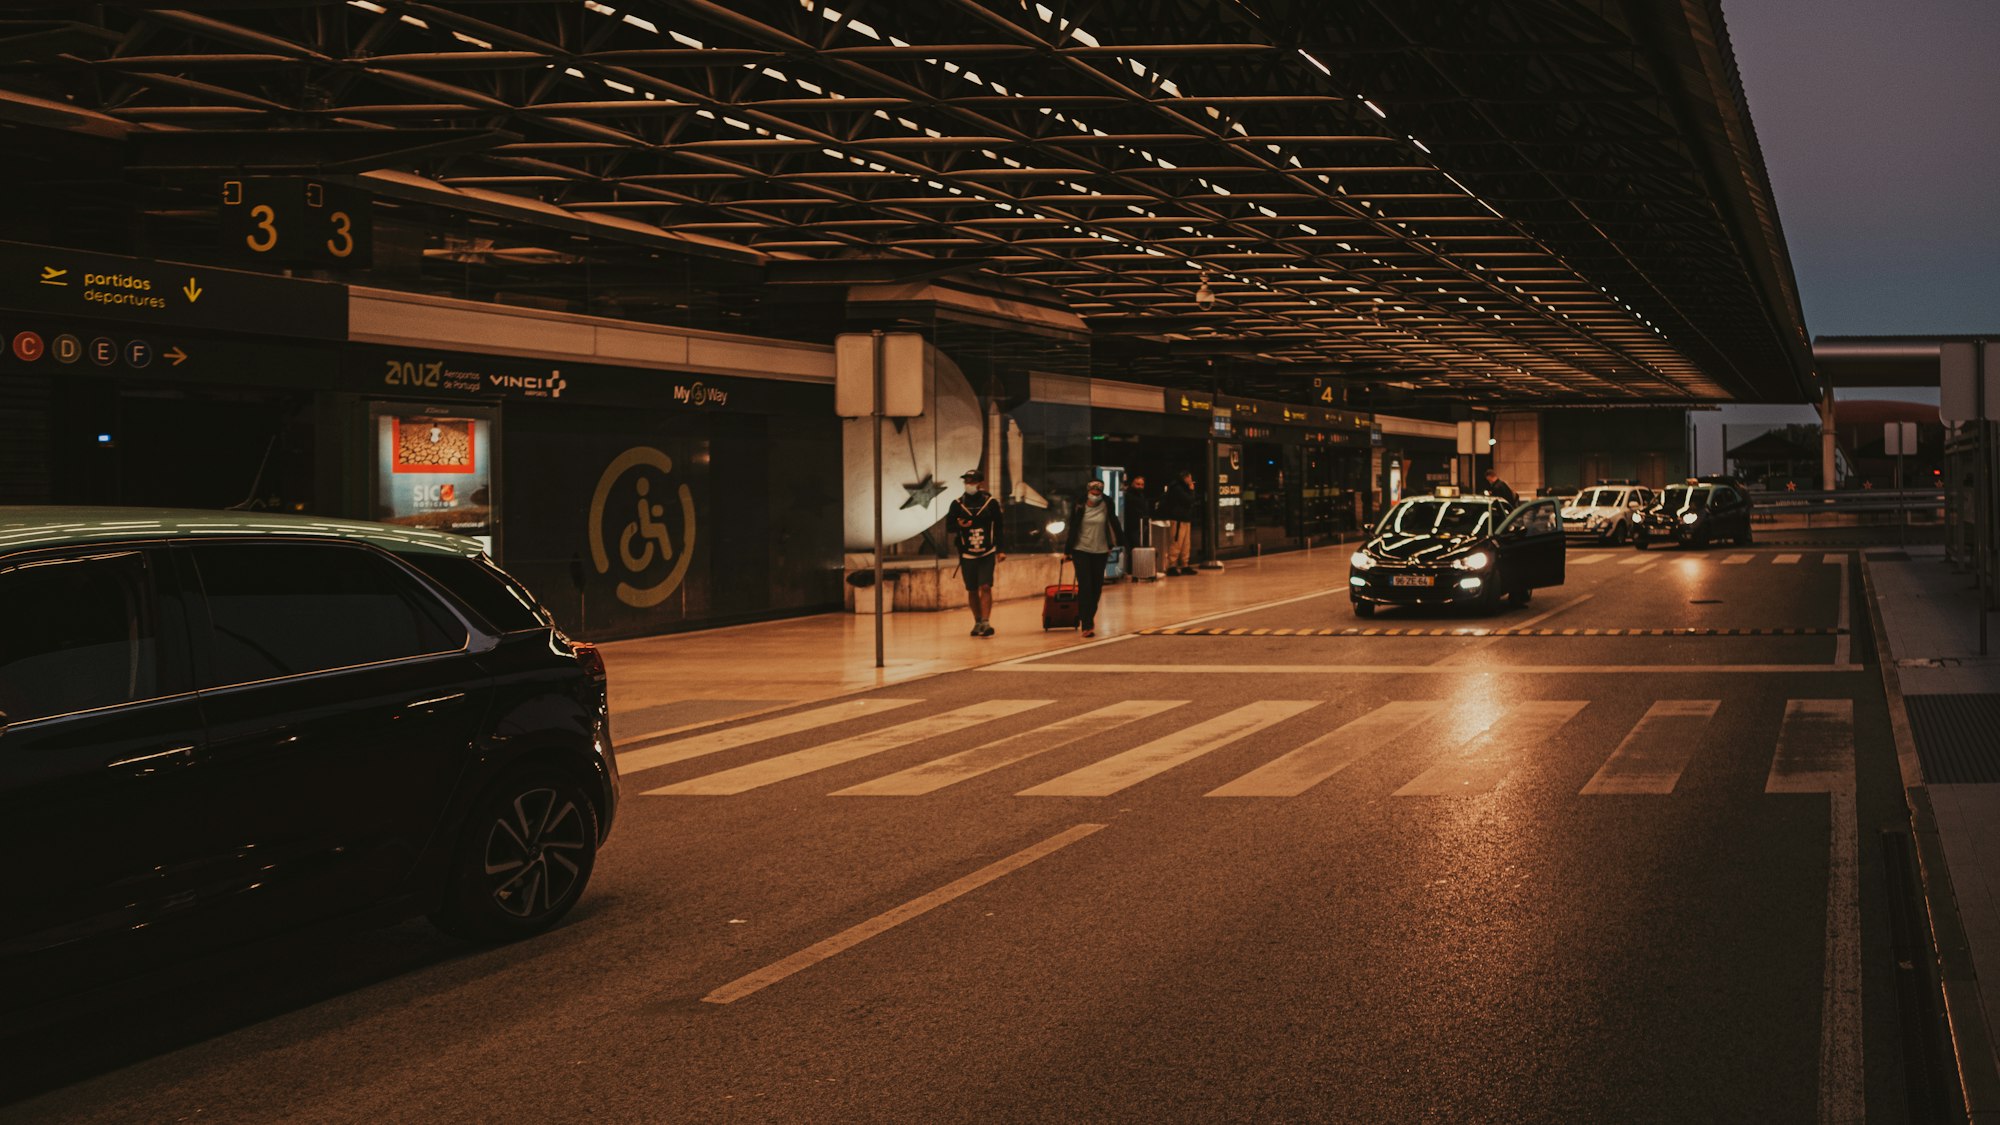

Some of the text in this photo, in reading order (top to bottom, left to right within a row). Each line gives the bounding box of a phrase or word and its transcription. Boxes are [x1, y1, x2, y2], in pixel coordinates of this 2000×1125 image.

[246, 204, 278, 252] 3
[327, 211, 354, 258] 3
[84, 273, 152, 291] partidas
[83, 289, 166, 309] departures
[21, 337, 145, 362] C D E F
[489, 374, 542, 389] VINCI
[673, 385, 728, 406] My Way
[1320, 385, 1334, 404] 4
[413, 484, 441, 502] SIC
